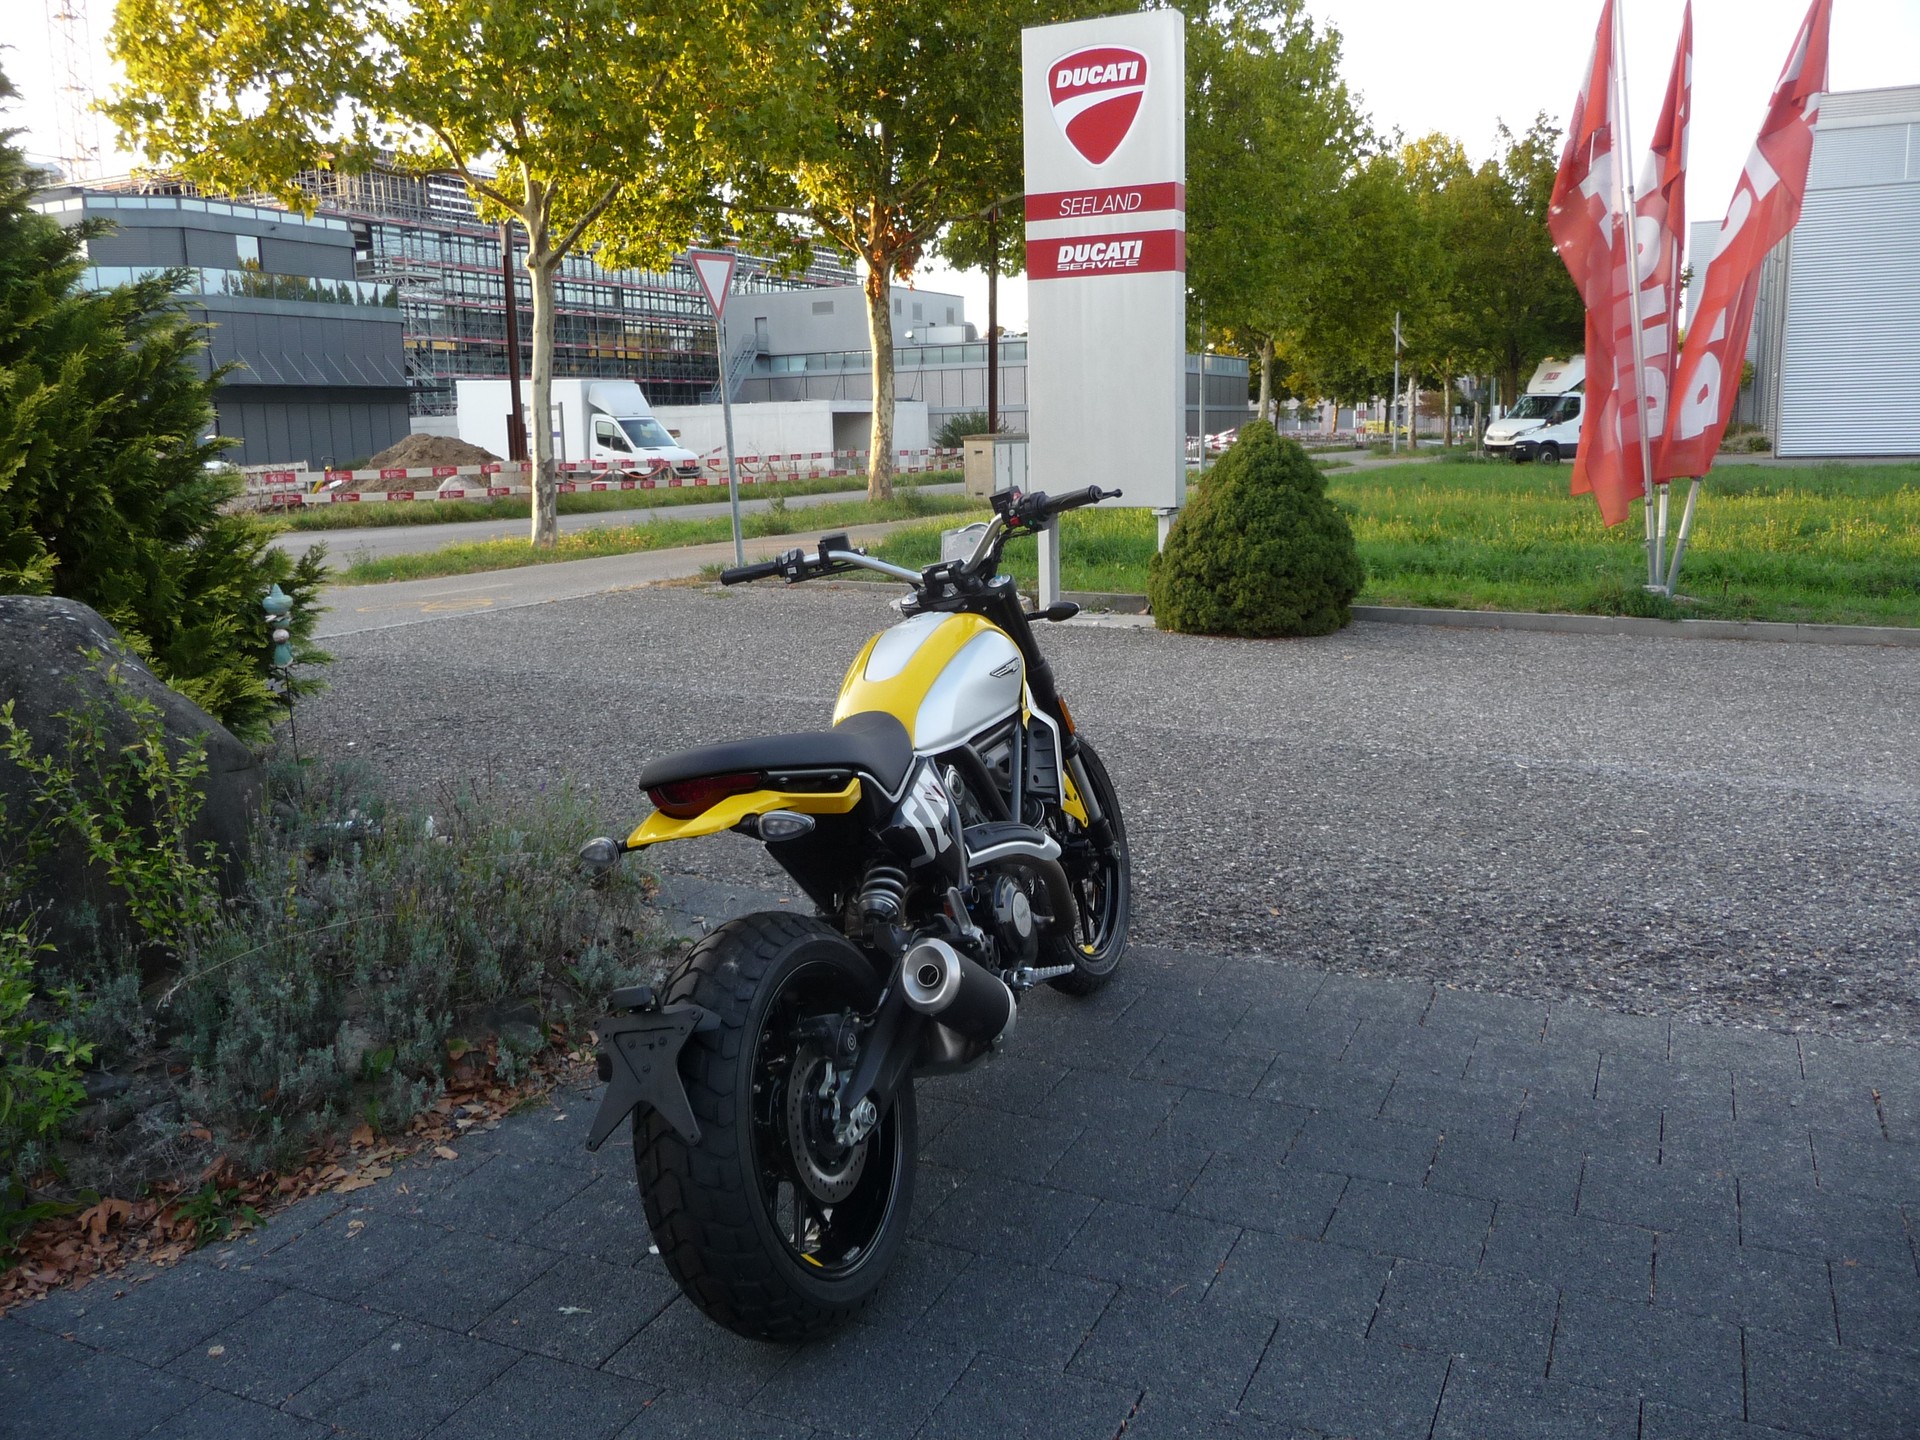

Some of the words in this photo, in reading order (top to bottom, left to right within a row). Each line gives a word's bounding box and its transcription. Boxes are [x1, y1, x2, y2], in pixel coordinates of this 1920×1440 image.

[1056, 61, 1139, 89] DUCATI
[1059, 192, 1142, 217] SEELAND
[1057, 240, 1143, 263] DUCATI
[1057, 259, 1139, 272] SERVICE
